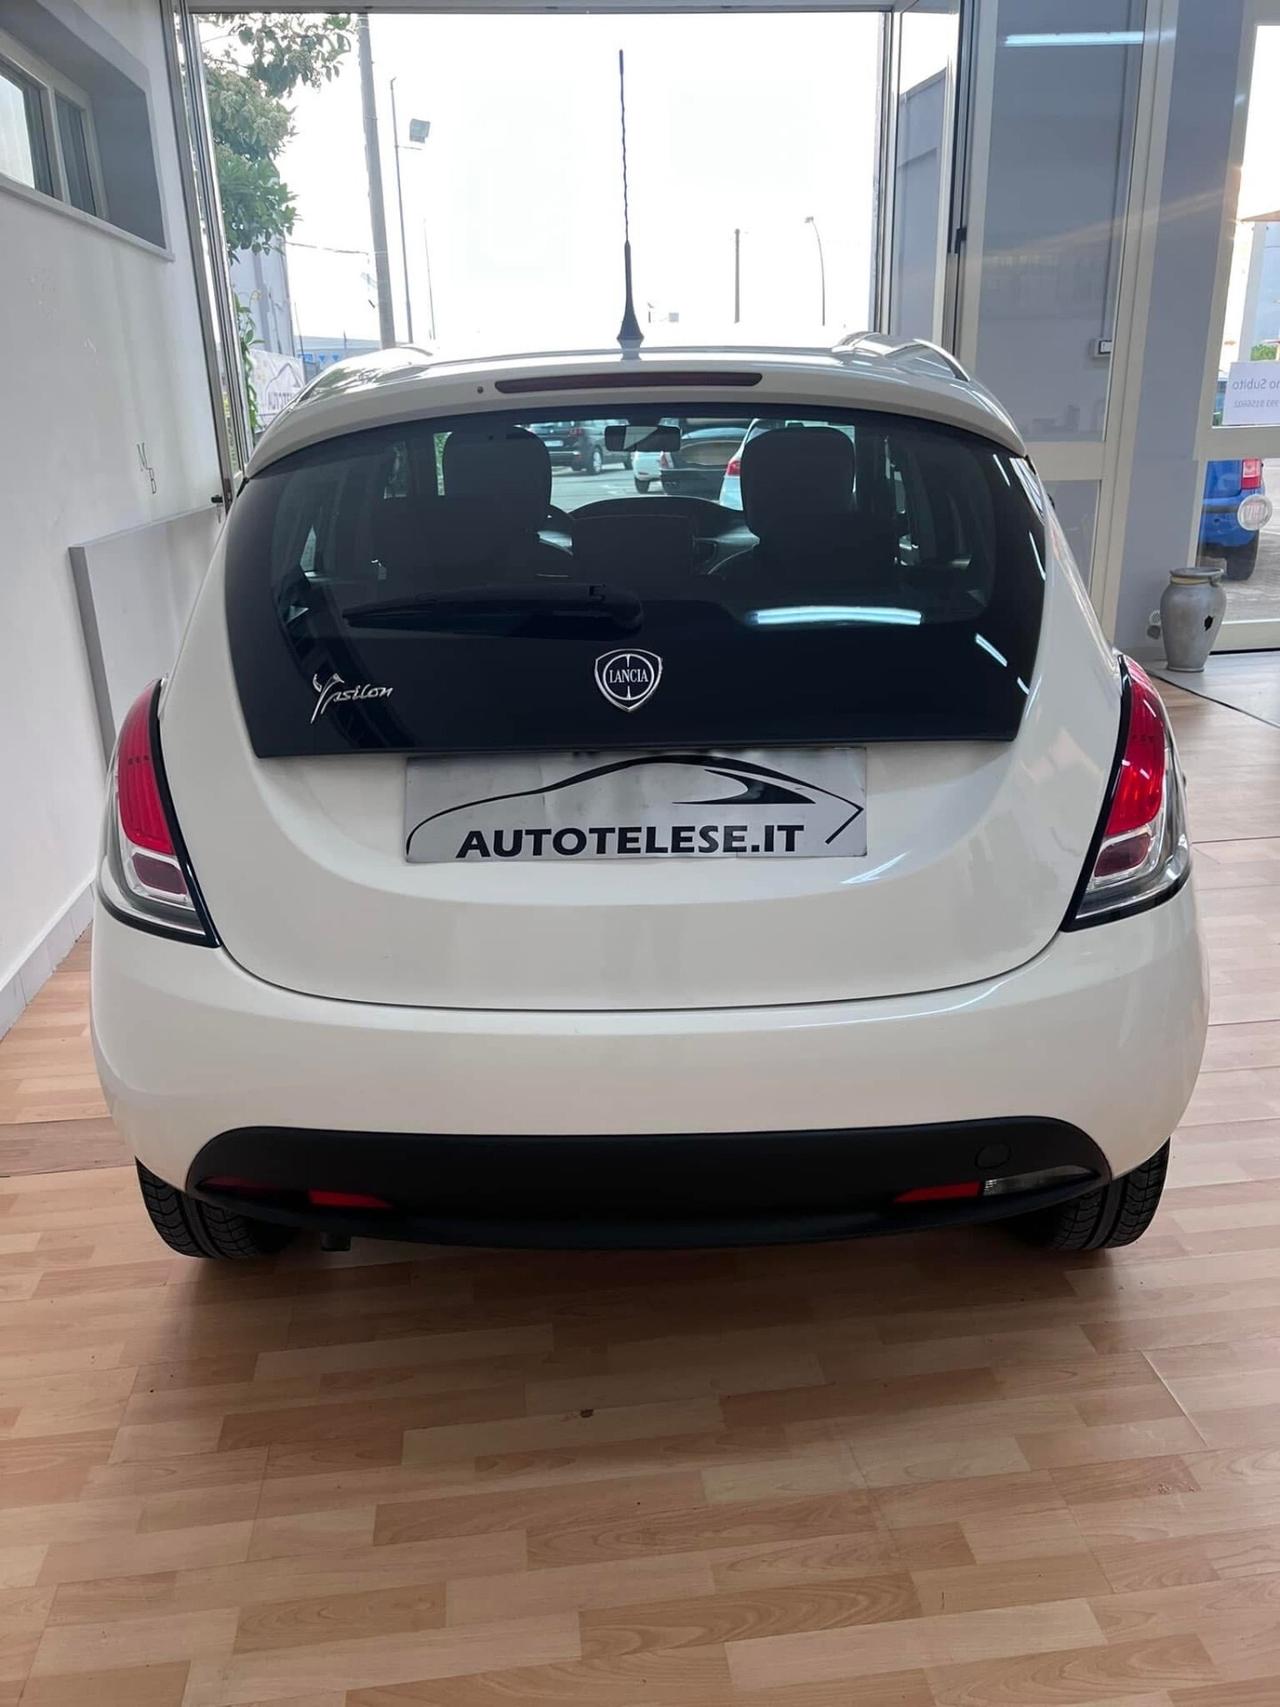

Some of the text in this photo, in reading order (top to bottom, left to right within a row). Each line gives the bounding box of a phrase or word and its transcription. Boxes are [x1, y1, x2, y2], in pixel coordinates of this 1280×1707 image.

[609, 669, 649, 683] LANCIA
[310, 673, 393, 724] Ypsilon
[455, 825, 805, 859] AUTOTELESE.IT
